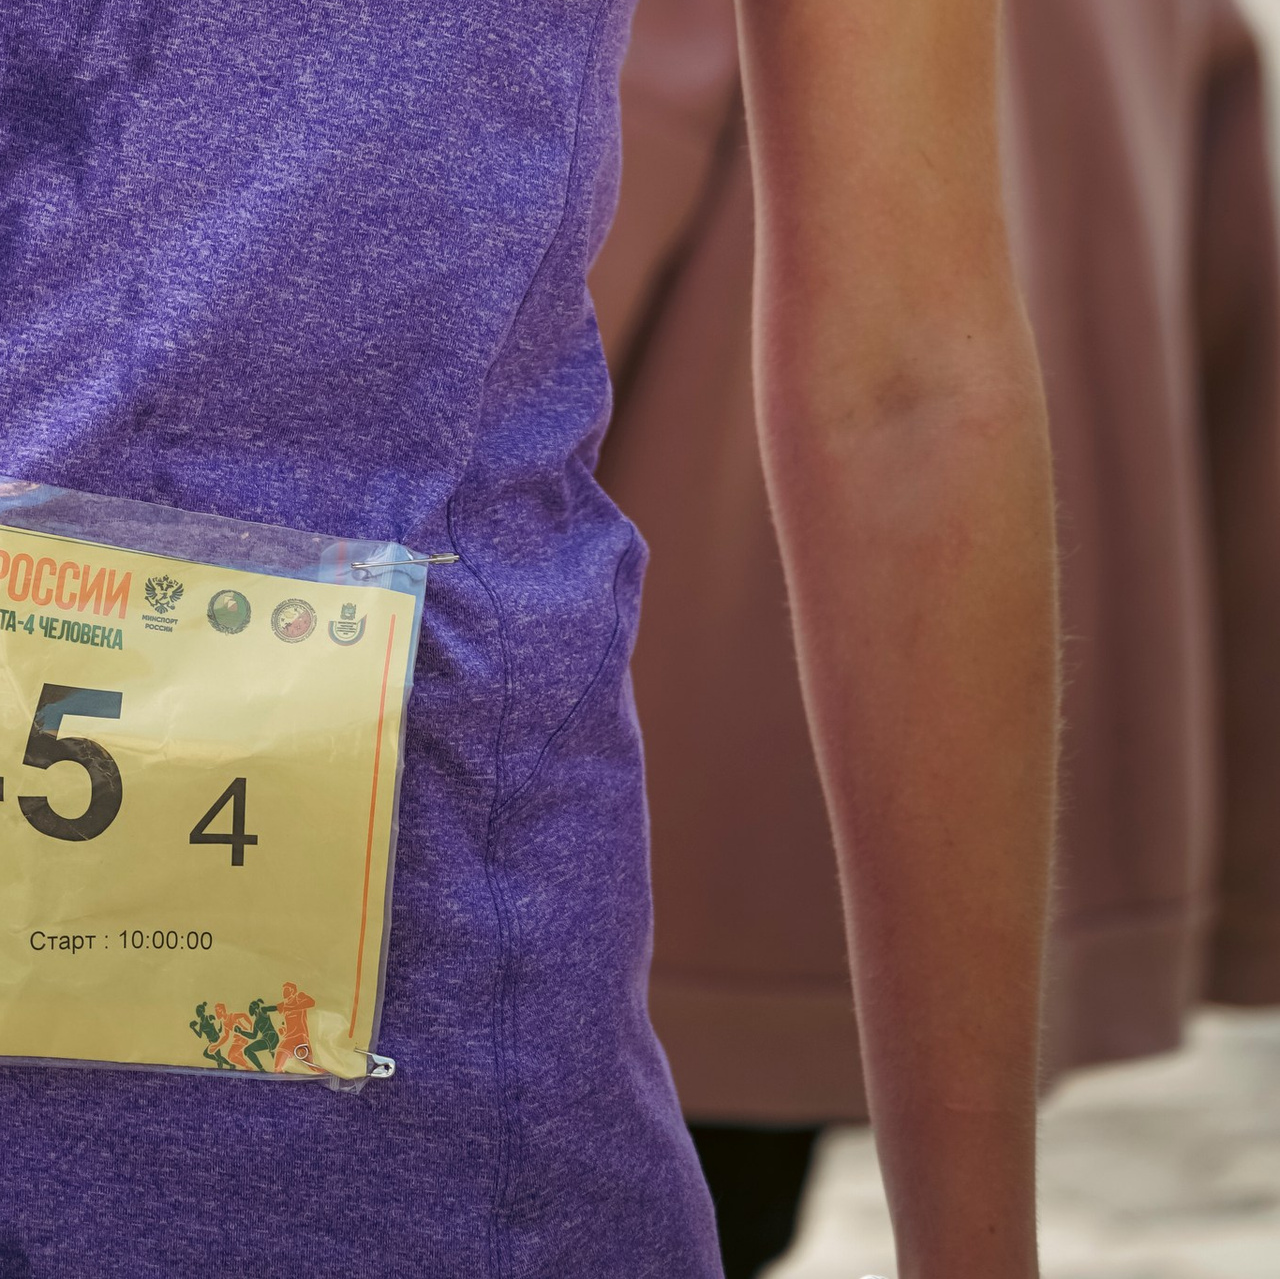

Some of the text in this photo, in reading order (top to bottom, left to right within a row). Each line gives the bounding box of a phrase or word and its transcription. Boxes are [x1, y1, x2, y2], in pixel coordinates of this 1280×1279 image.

[141, 614, 178, 625] МИНСПОРТ
[145, 623, 173, 633] РОССИИ
[39, 615, 123, 650] ЧЕЛОВЕКА
[189, 777, 258, 866] 4
[30, 930, 97, 954] Старт
[119, 929, 213, 950] 10:00:00
